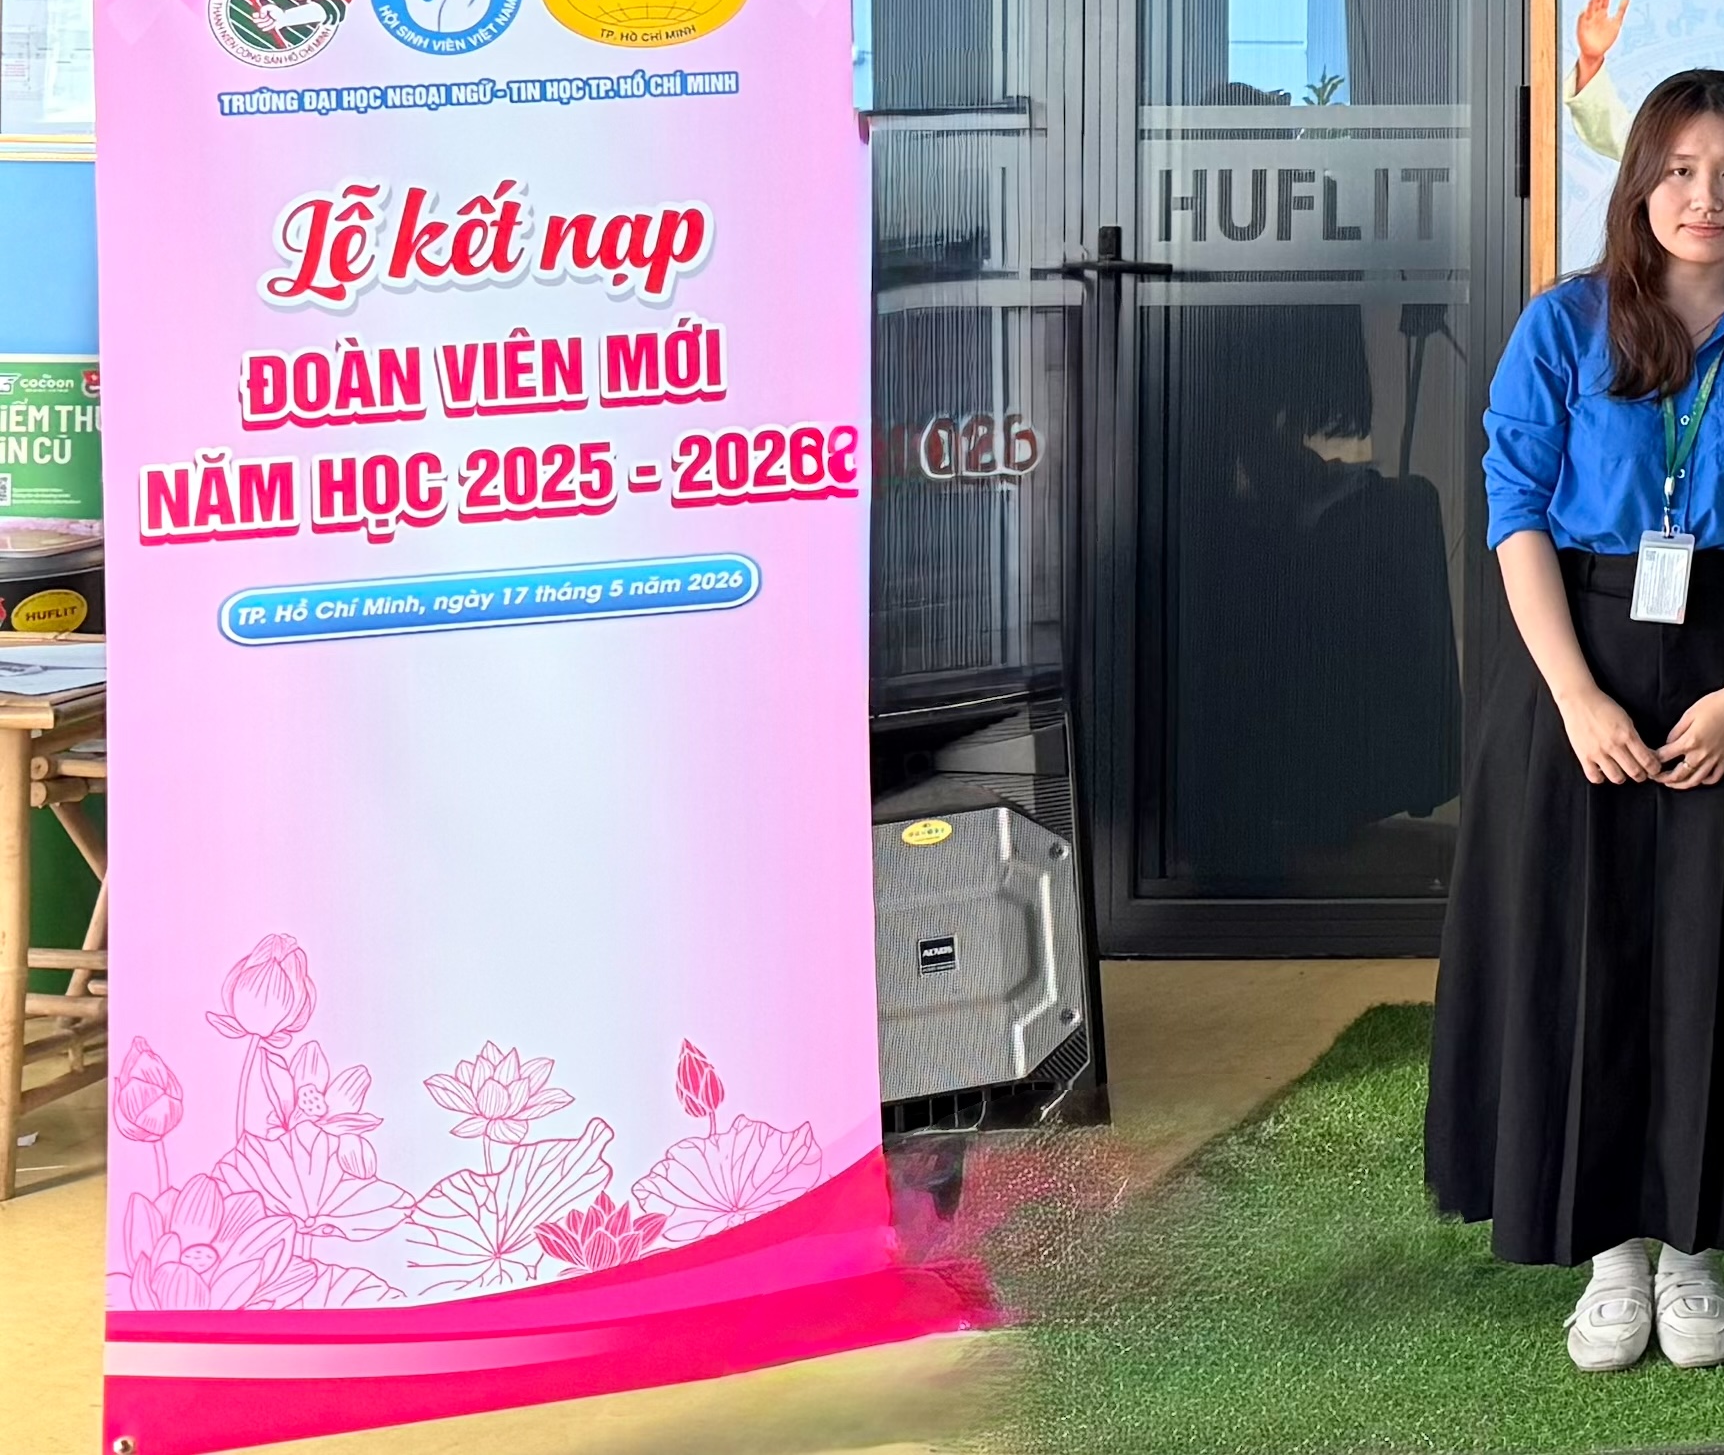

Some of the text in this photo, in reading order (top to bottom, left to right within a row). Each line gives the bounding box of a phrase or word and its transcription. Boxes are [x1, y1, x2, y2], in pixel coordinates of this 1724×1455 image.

[397, 25, 430, 49] SINH
[433, 35, 466, 52] VIÊN
[221, 88, 298, 114] TRƯỜNG
[303, 91, 338, 113] ĐẠI
[343, 89, 382, 114] HỌC
[387, 88, 446, 113] NGOẠI
[451, 79, 492, 106] NGỮ
[510, 82, 540, 102] TIN
[546, 81, 585, 106] HỌC
[588, 80, 614, 100] TP.
[651, 72, 683, 96] CHÍ
[687, 74, 736, 94] MINH
[1159, 167, 1450, 241] HUFLIT
[266, 180, 704, 301] Lễ kết nạp
[243, 317, 722, 418] ĐOÀN VIÊN MỚI
[145, 450, 295, 531] NĂM
[318, 452, 446, 540] HỌC
[464, 442, 614, 511] 2025
[26, 606, 77, 622] HUFLIT
[238, 606, 267, 627] TP.
[315, 596, 359, 622] Chí
[363, 593, 425, 617] Minh,
[433, 588, 494, 616] ngày
[502, 586, 528, 605] 17
[536, 580, 602, 606] tháng
[608, 579, 624, 597] 5
[629, 574, 681, 596] năm
[687, 570, 744, 591] 2026
